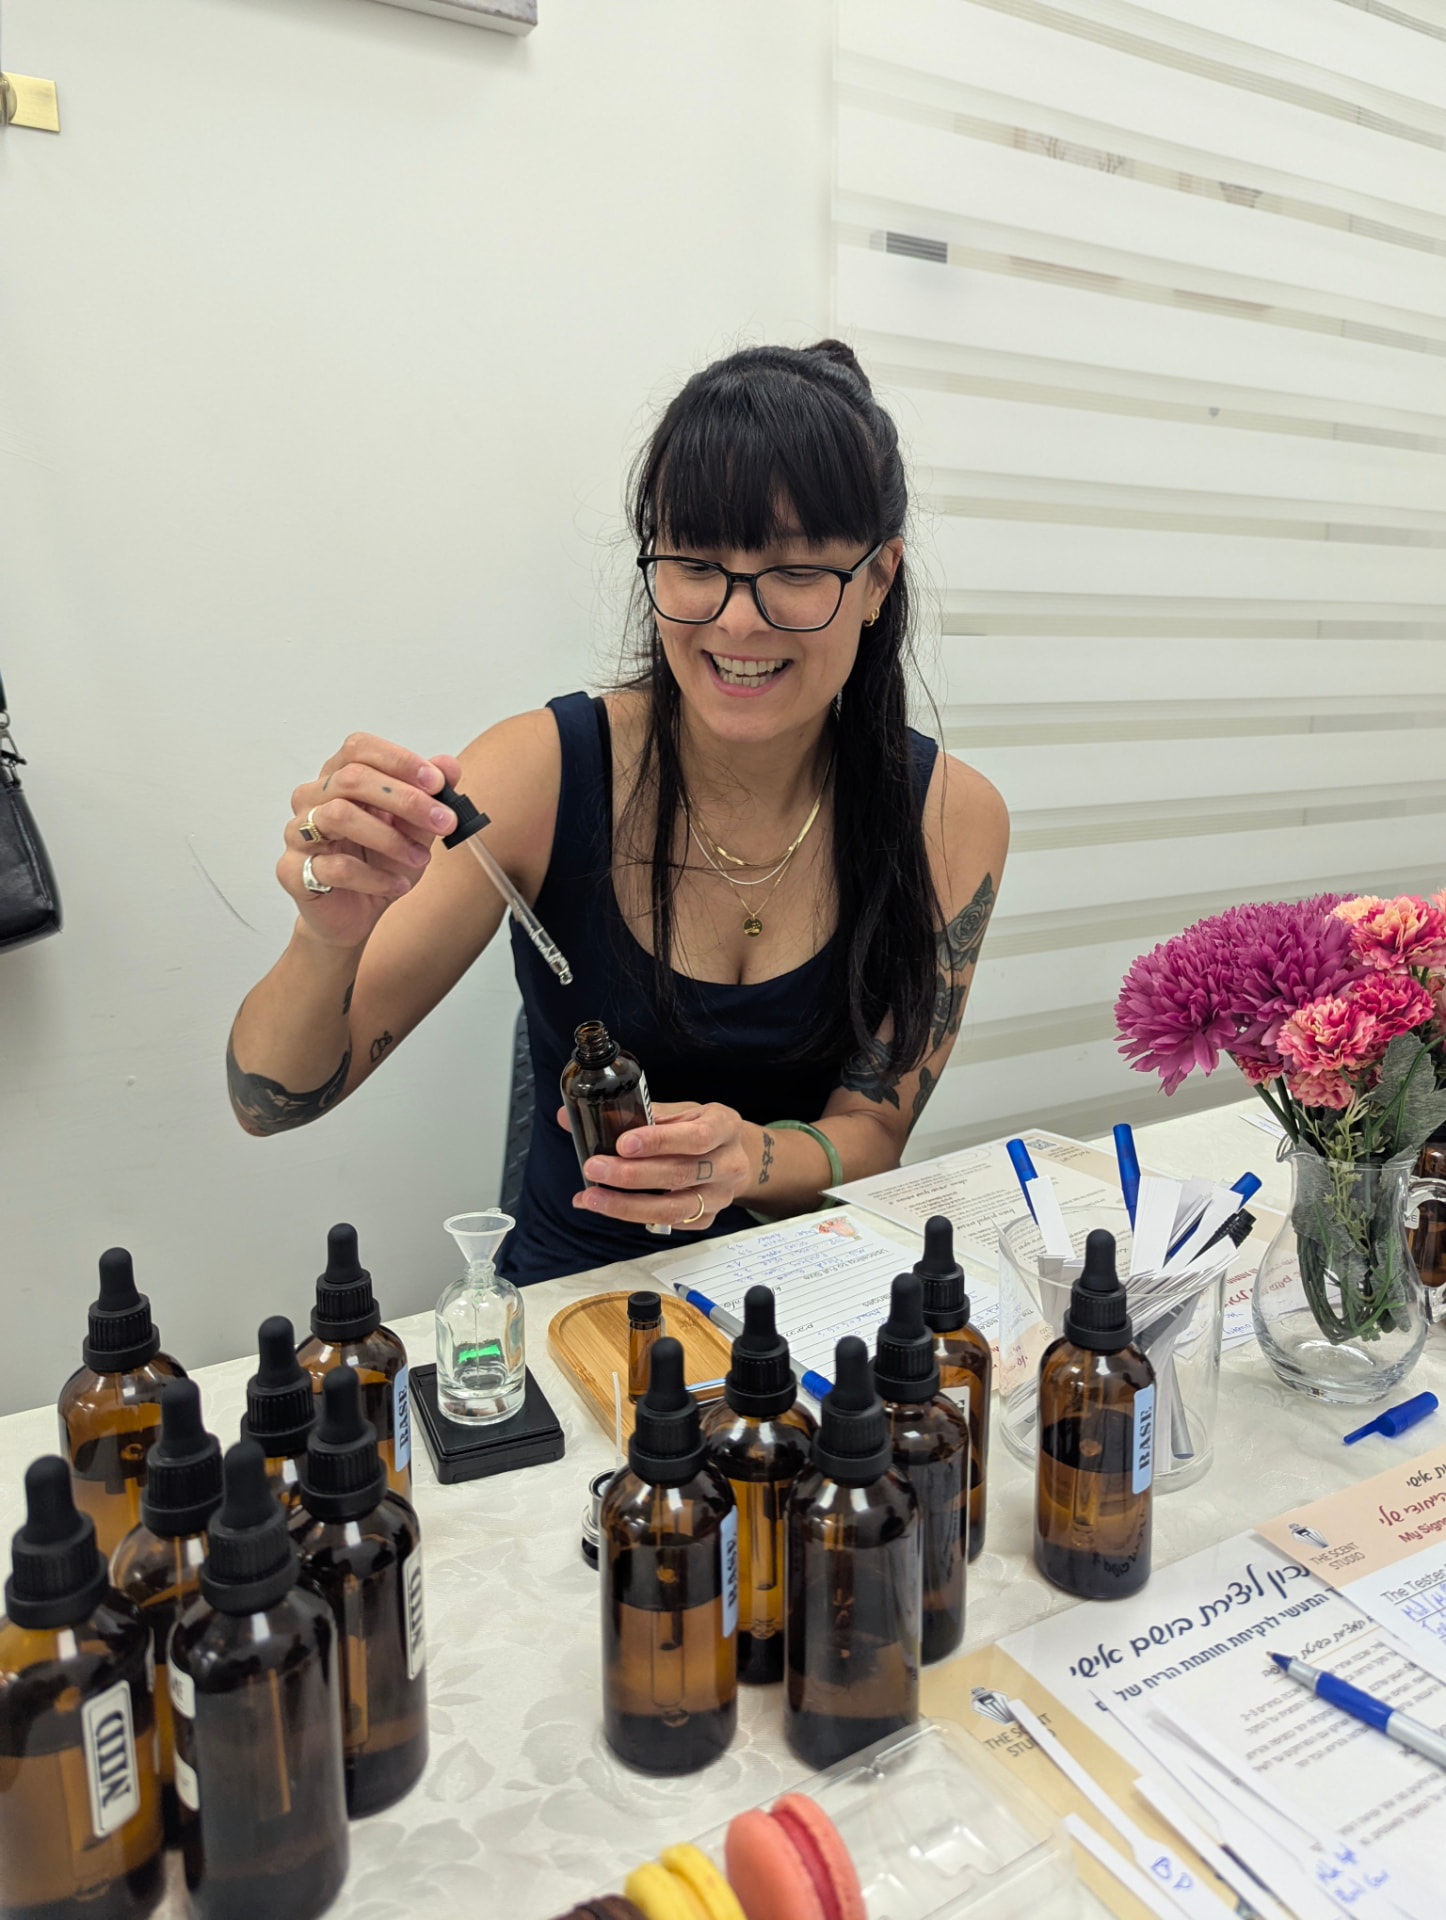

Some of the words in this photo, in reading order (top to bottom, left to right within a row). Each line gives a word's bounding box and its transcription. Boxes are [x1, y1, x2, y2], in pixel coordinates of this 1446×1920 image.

[1138, 1405, 1153, 1471] BASE
[1397, 1528, 1424, 1543] My
[1309, 1550, 1332, 1566] THE
[1329, 1541, 1360, 1558] SCENT
[1328, 1551, 1366, 1571] STUDIO
[1200, 1563, 1264, 1628] ליצירת
[1380, 1588, 1410, 1603] The
[1404, 1566, 1446, 1590] Tester
[1278, 1591, 1331, 1621] המעשי
[1129, 1616, 1194, 1658] בושם
[1227, 1614, 1281, 1647] לרקיחת
[1069, 1643, 1124, 1679] אישי
[1180, 1639, 1230, 1671] חותמת
[1142, 1661, 1181, 1690] הריח
[984, 1731, 1013, 1750] THE
[95, 1710, 131, 1808] MID
